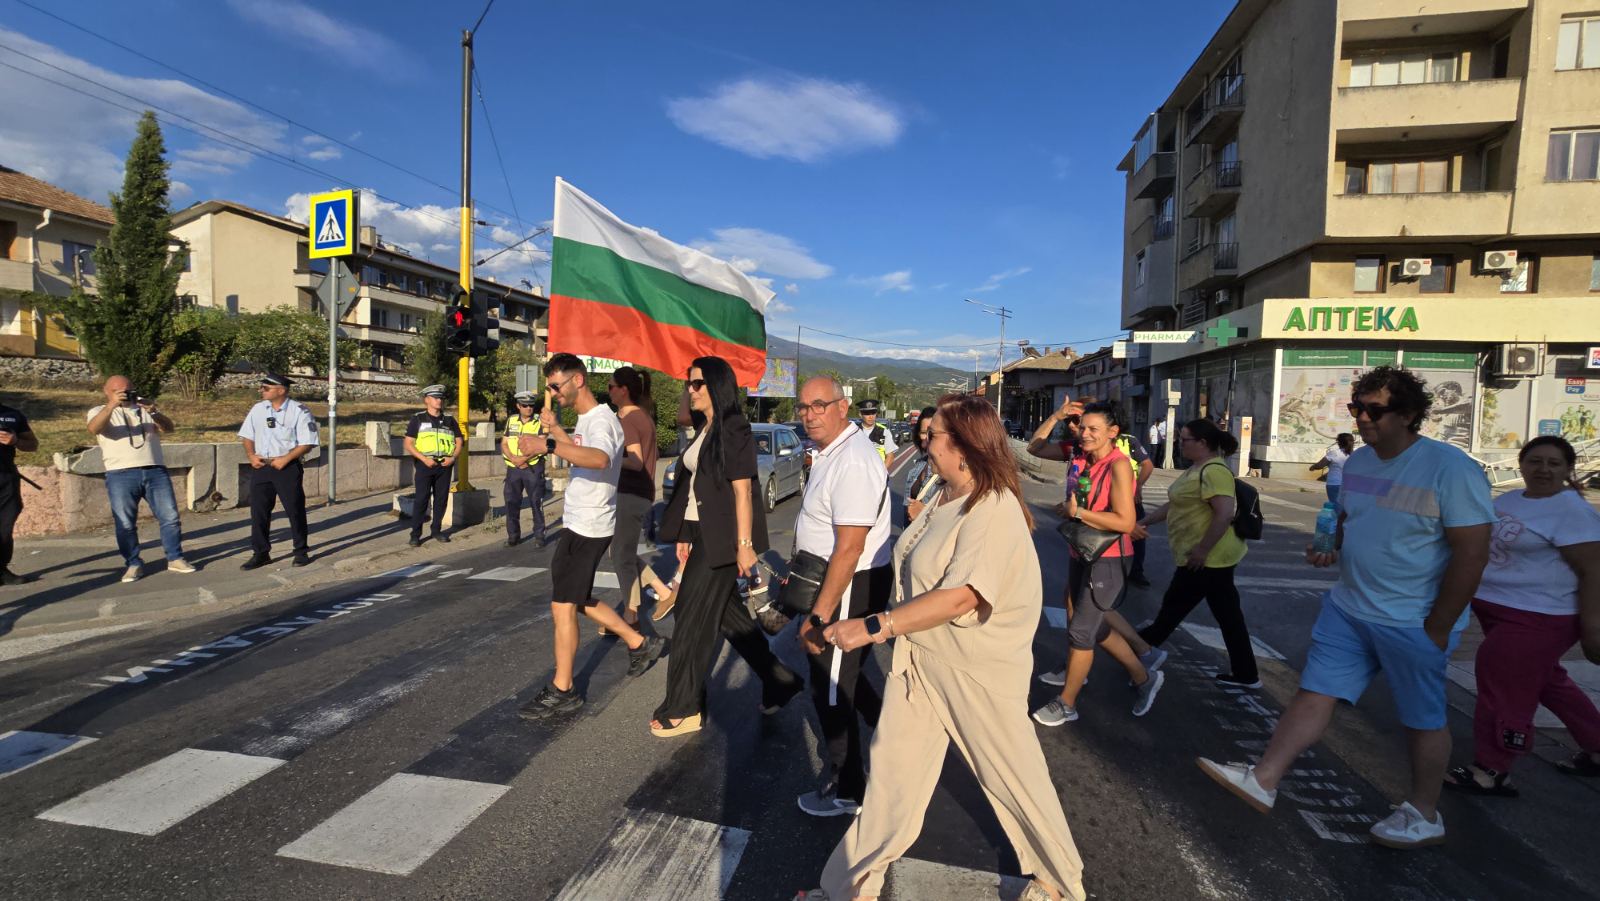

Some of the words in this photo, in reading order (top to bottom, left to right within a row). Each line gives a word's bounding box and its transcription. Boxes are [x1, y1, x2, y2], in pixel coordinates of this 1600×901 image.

[1282, 306, 1419, 332] АПТЕКА
[586, 358, 625, 370] RMACY
[1567, 378, 1585, 386] Easy
